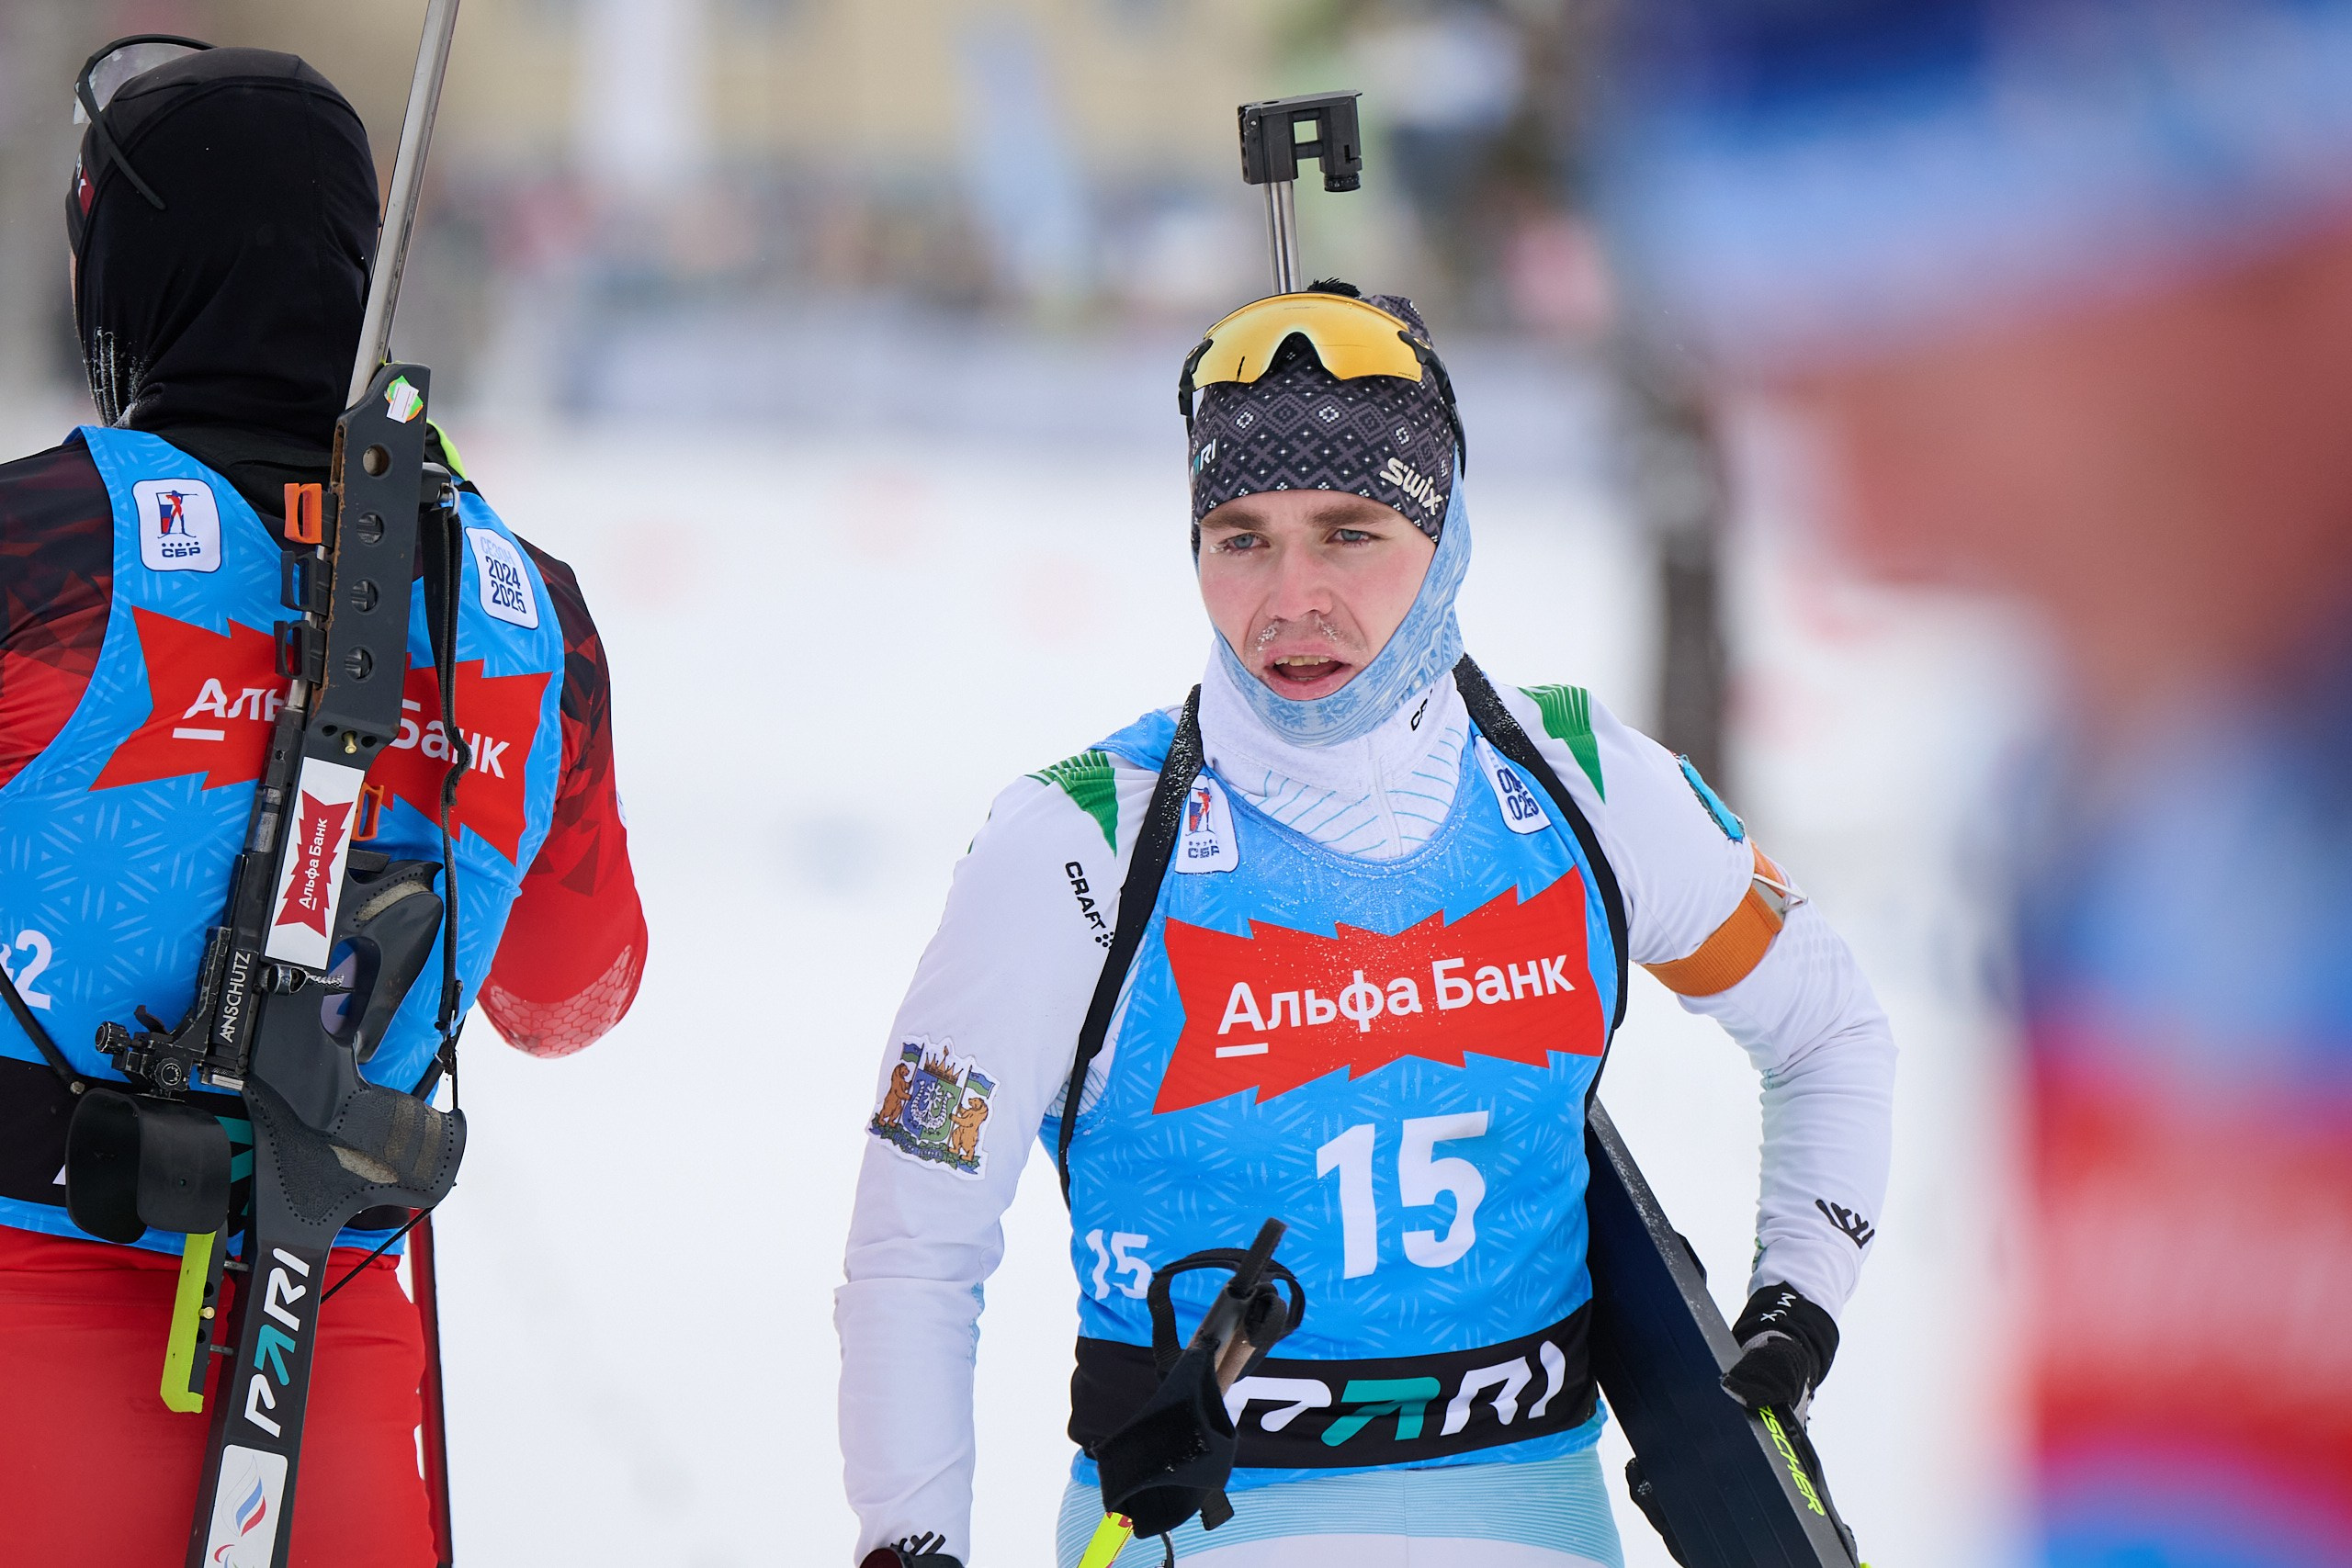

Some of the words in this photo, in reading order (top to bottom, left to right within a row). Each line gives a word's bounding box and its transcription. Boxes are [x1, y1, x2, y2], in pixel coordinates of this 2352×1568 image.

[485, 556, 521, 590] 2024
[491, 580, 526, 614] 2025
[308, 818, 328, 857] Банк
[1502, 790, 1540, 821] 025
[299, 858, 320, 910] Альфа
[1065, 861, 1107, 931] CRAFT
[1216, 968, 1423, 1036] Альфа
[1430, 953, 1577, 1011] Банк
[1315, 1110, 1489, 1280] 15
[1085, 1228, 1152, 1302] 15
[243, 1247, 311, 1438] PARI
[1758, 1405, 1825, 1516] ISCHER
